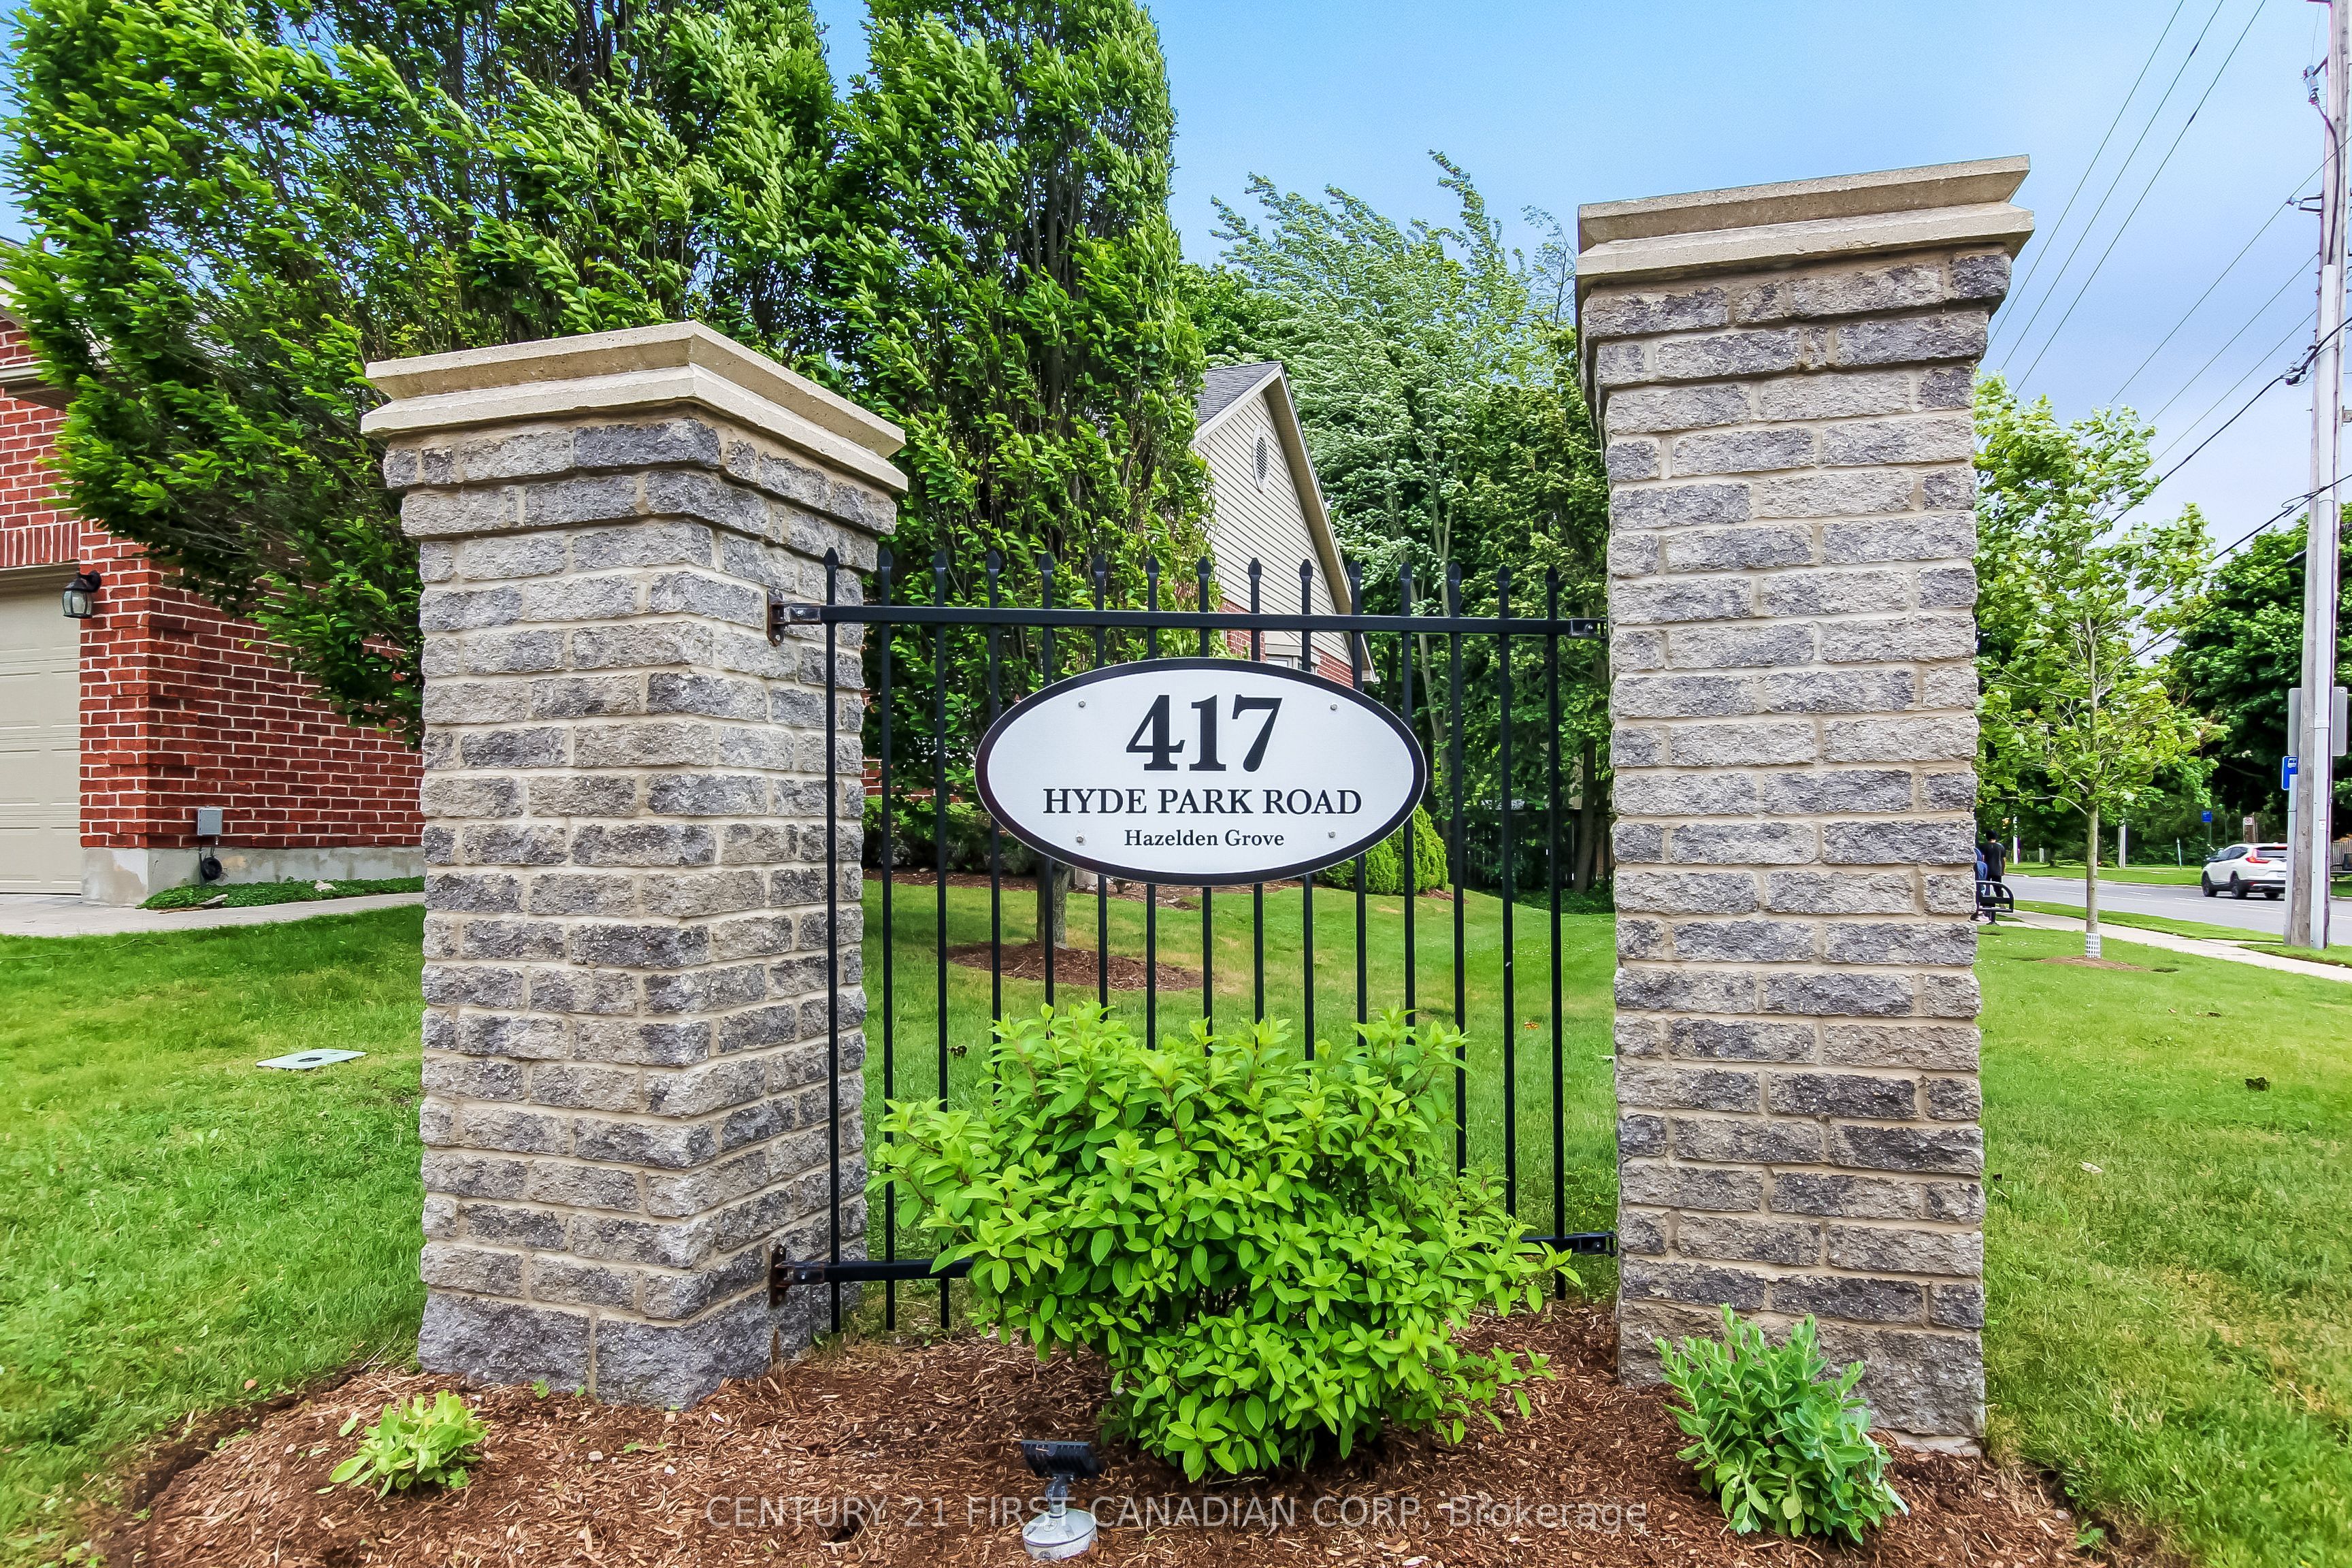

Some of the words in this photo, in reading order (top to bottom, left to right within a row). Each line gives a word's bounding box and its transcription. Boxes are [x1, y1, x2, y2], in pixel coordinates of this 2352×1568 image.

[1126, 693, 1283, 772] 417
[1043, 788, 1147, 814] HYDE
[1157, 788, 1254, 814] PARK
[1262, 789, 1362, 815] ROAD
[1124, 829, 1219, 846] Hazelden
[1224, 829, 1284, 847] Grove
